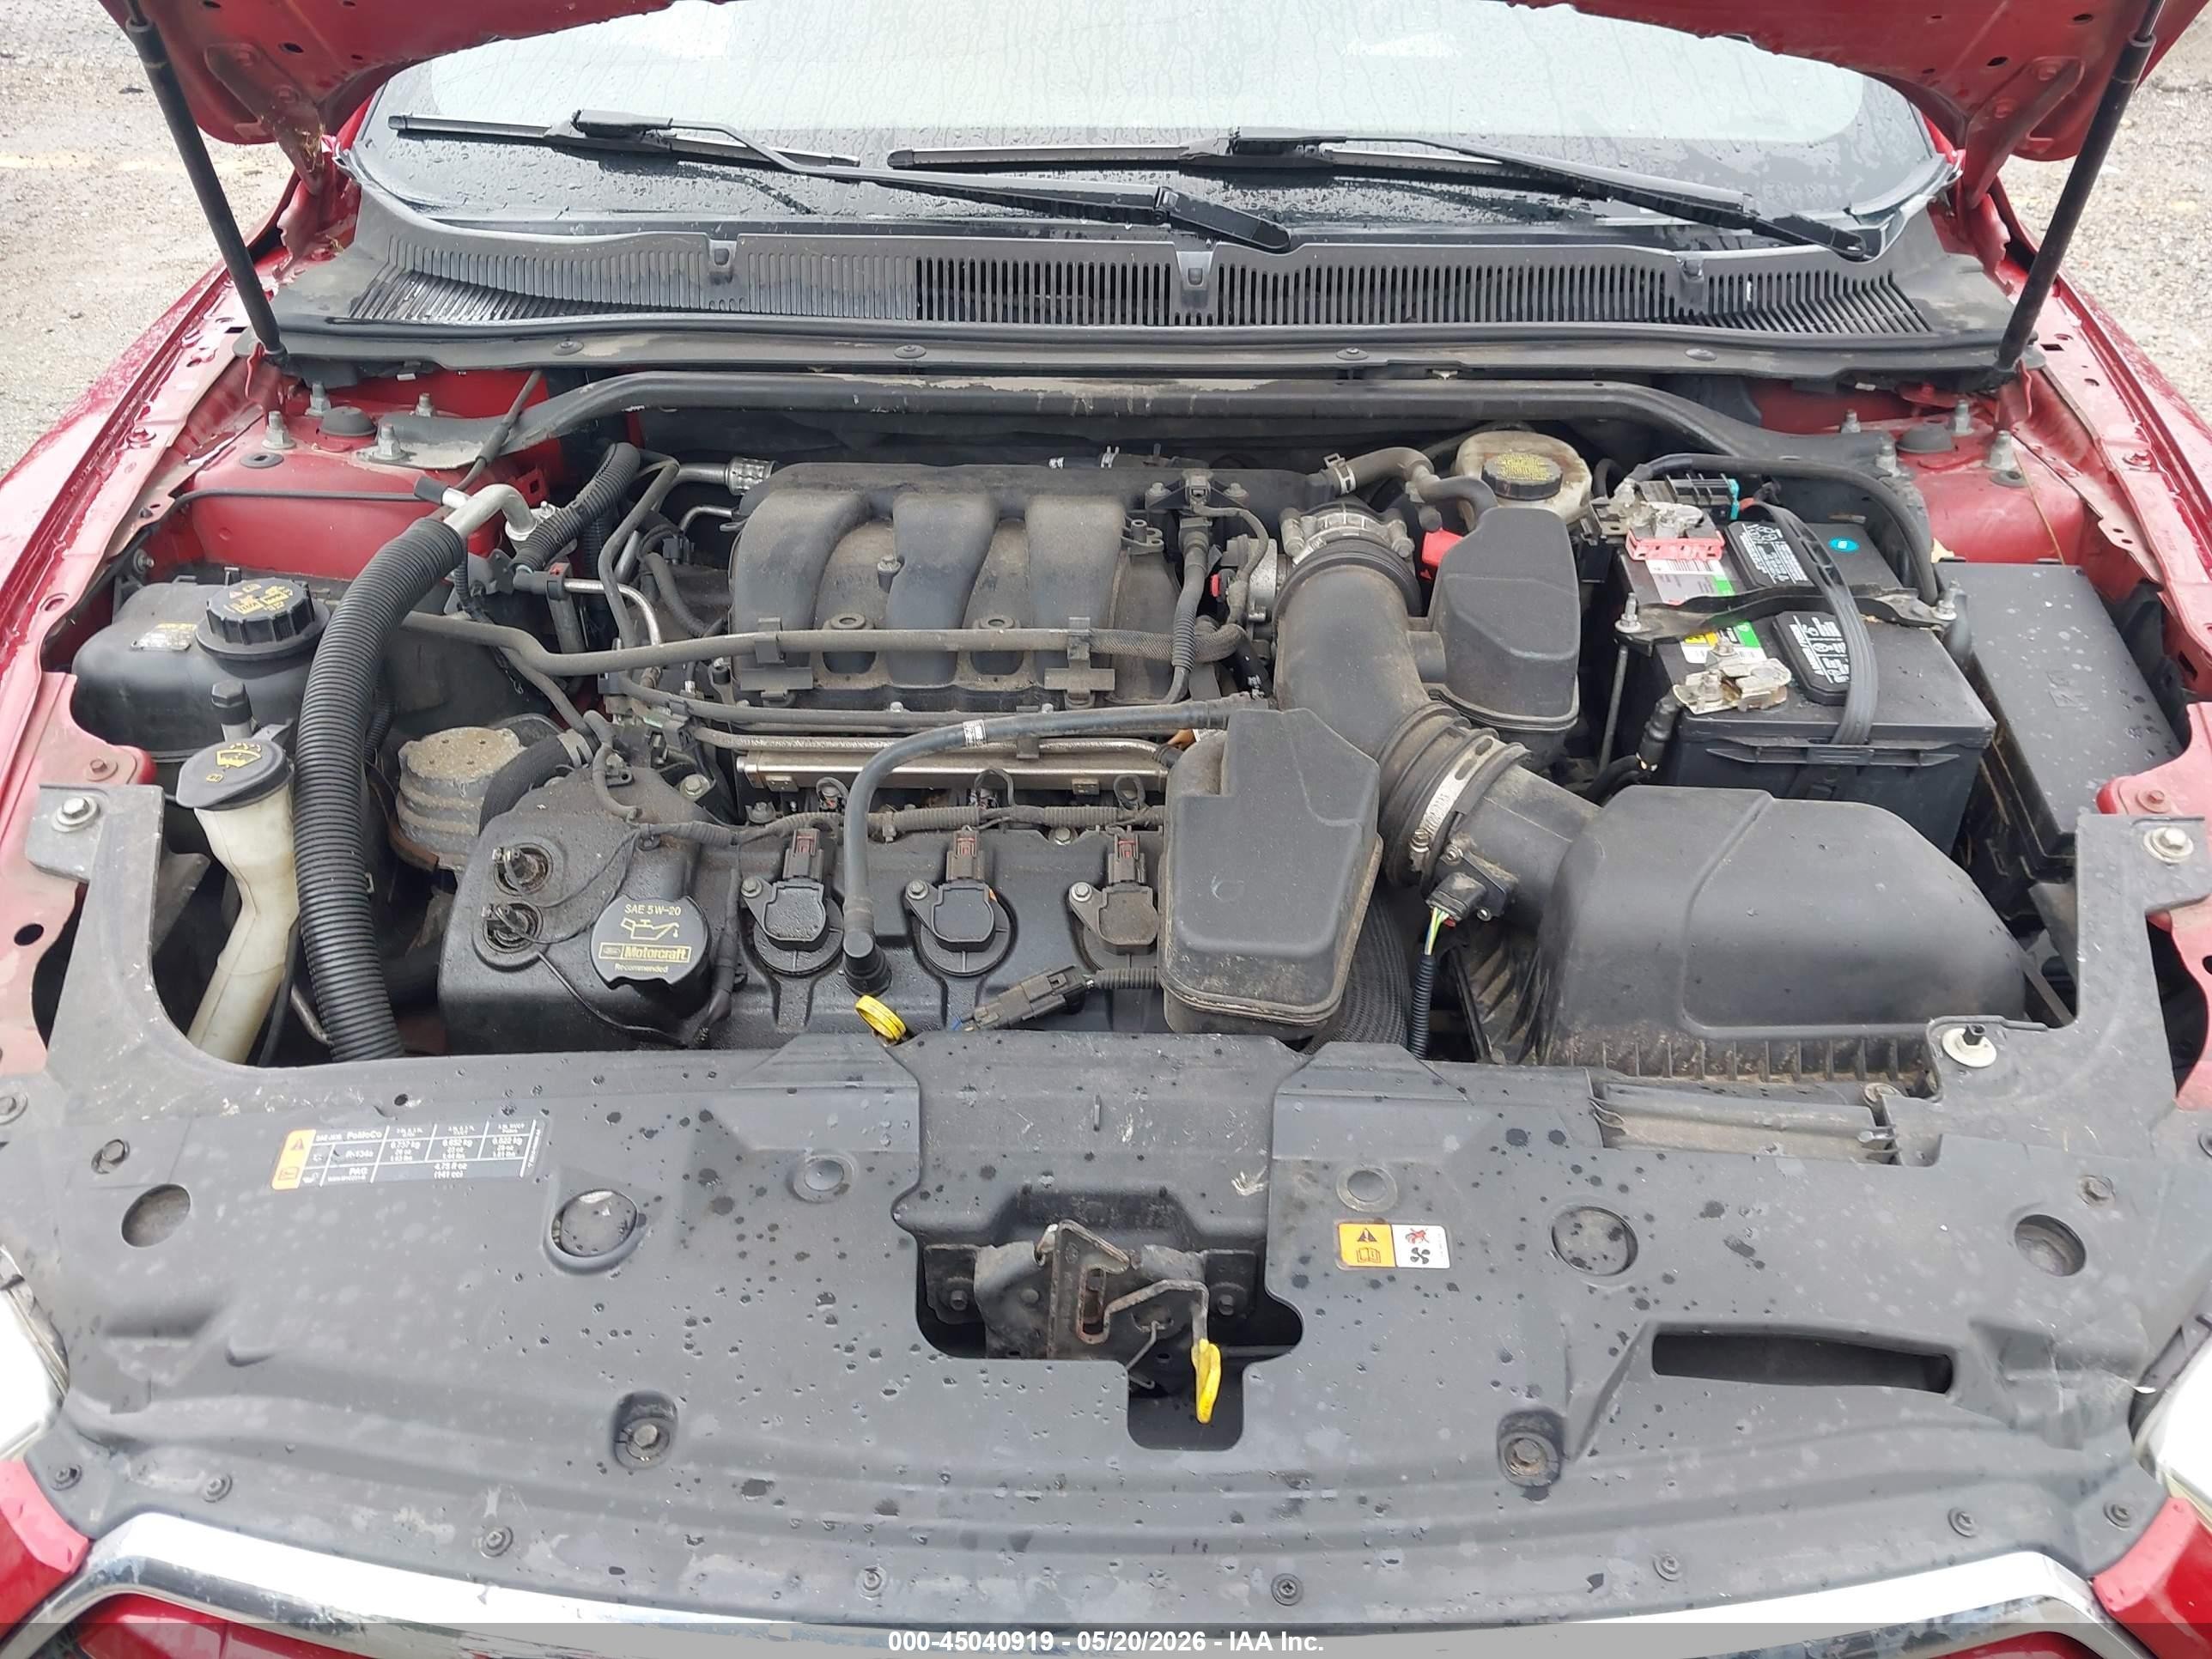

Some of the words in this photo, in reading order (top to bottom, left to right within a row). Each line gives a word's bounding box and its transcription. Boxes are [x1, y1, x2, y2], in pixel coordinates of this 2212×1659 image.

[624, 903, 646, 915] SAE
[646, 904, 682, 916] 5W-20
[624, 946, 686, 960] Motorcraft
[614, 963, 669, 974] Recommended
